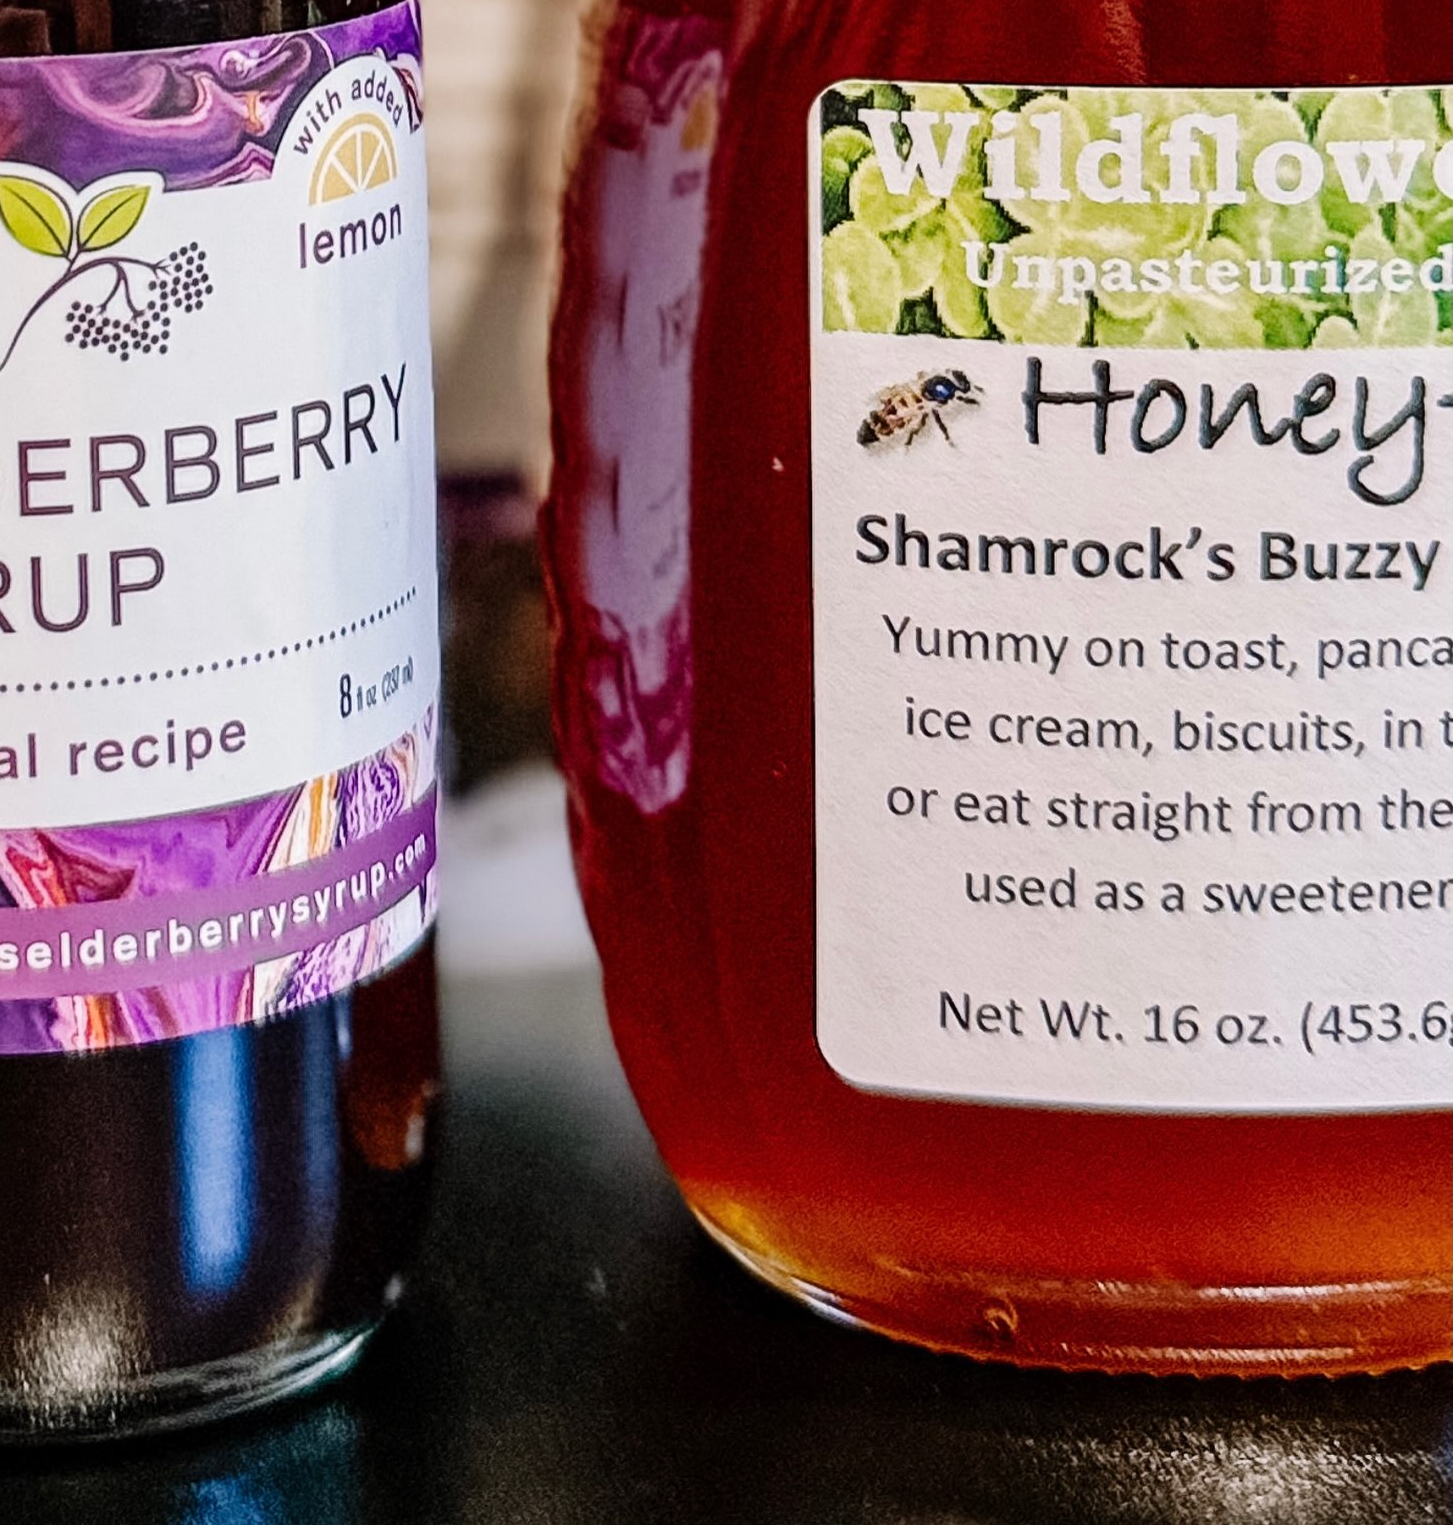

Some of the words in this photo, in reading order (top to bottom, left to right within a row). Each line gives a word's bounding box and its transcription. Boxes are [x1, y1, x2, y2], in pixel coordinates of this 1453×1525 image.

[294, 89, 343, 155] with
[350, 70, 403, 128] added
[299, 203, 402, 269] lemon
[961, 241, 1453, 305] Unpasteurized
[1021, 356, 1426, 506] Honey
[855, 514, 1237, 582] Shamrock’s
[1259, 531, 1441, 592] Buzzy
[882, 614, 1068, 675] Yummy
[1084, 634, 1145, 668] on
[1161, 632, 1299, 677] toast,
[339, 673, 352, 719] 8
[904, 697, 972, 741] ice
[988, 711, 1155, 758] cream,
[1173, 709, 1366, 758] biscuits,
[1382, 709, 1424, 749] in
[68, 714, 248, 777] recipe
[886, 784, 938, 819] or
[953, 788, 1031, 827] eat
[1046, 790, 1232, 842] straight
[1248, 790, 1362, 834] from
[1378, 788, 1453, 831] the
[965, 866, 1076, 910] used
[1093, 878, 1144, 911] as
[1160, 880, 1185, 913] a
[938, 990, 1023, 1039] Net
[1038, 998, 1124, 1043] Wt.
[1143, 1003, 1199, 1044] 16
[1216, 1011, 1282, 1046] oz.
[1300, 1000, 1453, 1054] (453.6
